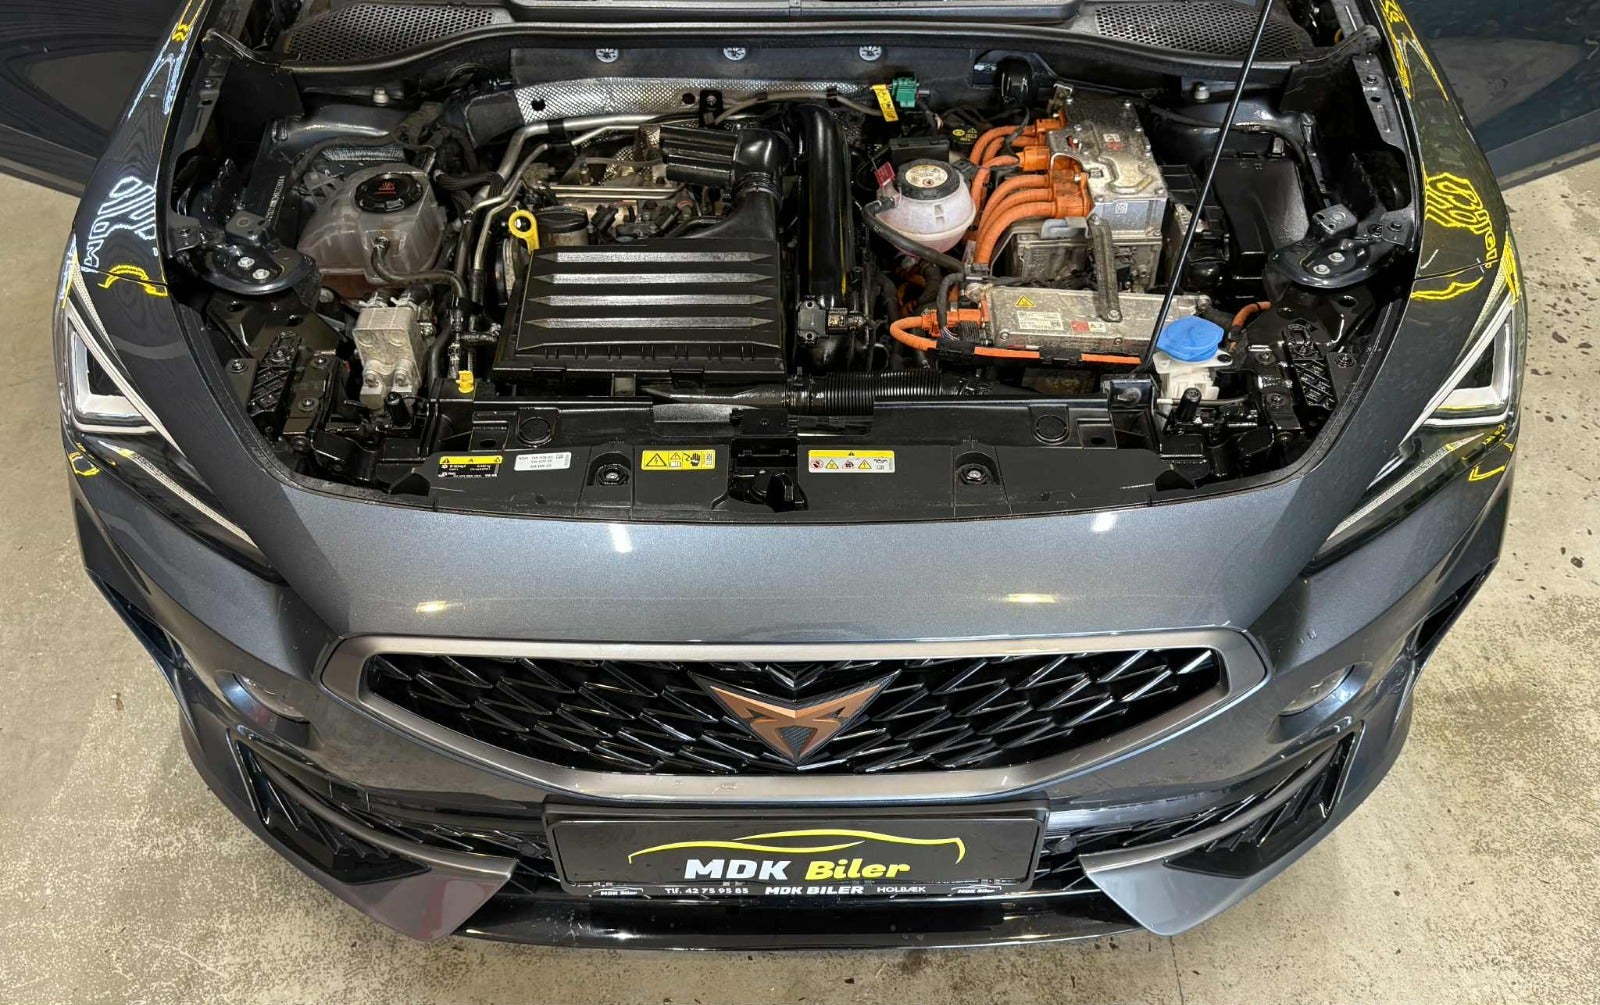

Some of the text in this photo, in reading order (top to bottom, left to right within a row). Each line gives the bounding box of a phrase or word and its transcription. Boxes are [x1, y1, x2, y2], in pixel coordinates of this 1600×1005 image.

[684, 858, 911, 881] MDK Biler
[764, 886, 865, 895] MDK BILER
